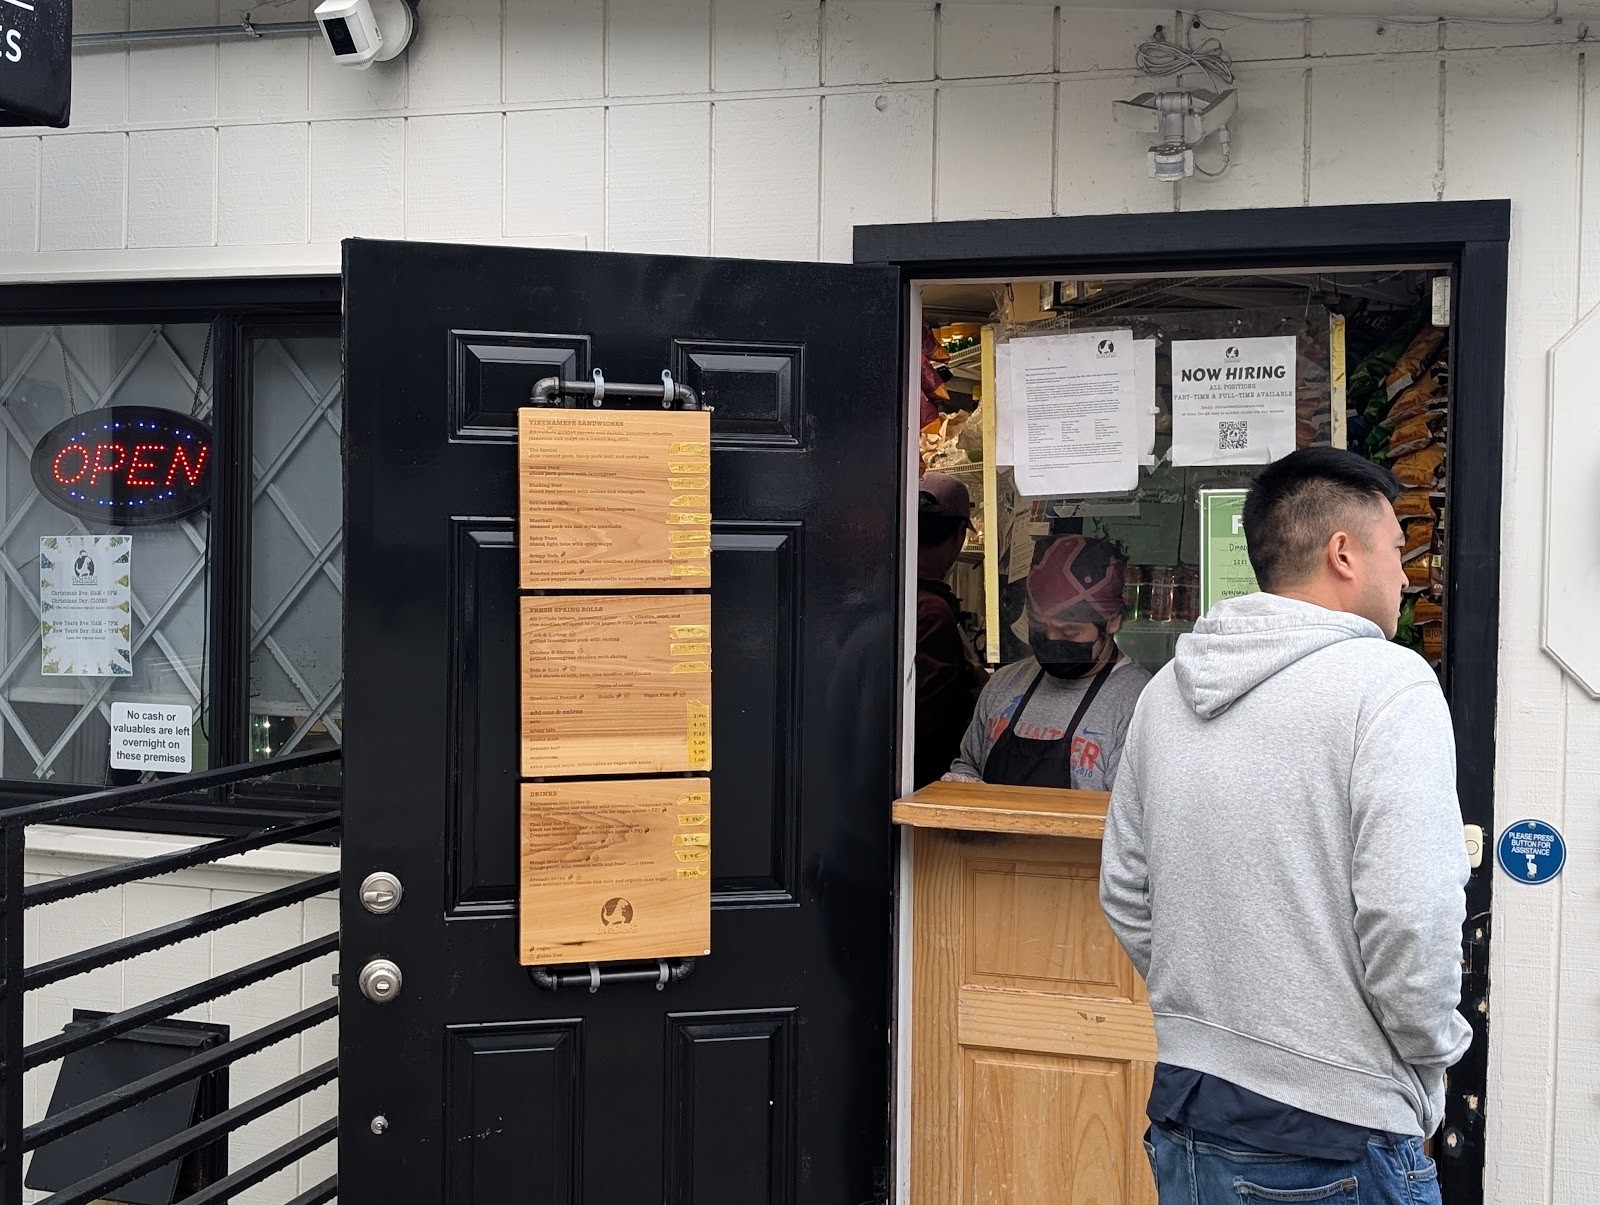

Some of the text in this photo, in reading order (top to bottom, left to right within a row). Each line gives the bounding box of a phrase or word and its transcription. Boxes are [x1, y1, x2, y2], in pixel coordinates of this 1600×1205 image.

[0, 25, 22, 63] S
[1181, 365, 1286, 382] NOW HIRING
[54, 444, 208, 487] OPEN
[127, 710, 177, 722] No cash or
[113, 723, 190, 736] valuables are left
[122, 738, 180, 751] overnight on
[116, 750, 186, 764] these premises
[1508, 832, 1555, 843] PLEASE PRESS
[1511, 839, 1537, 848] BUTTON
[1511, 846, 1550, 856] ASSISTANCE
